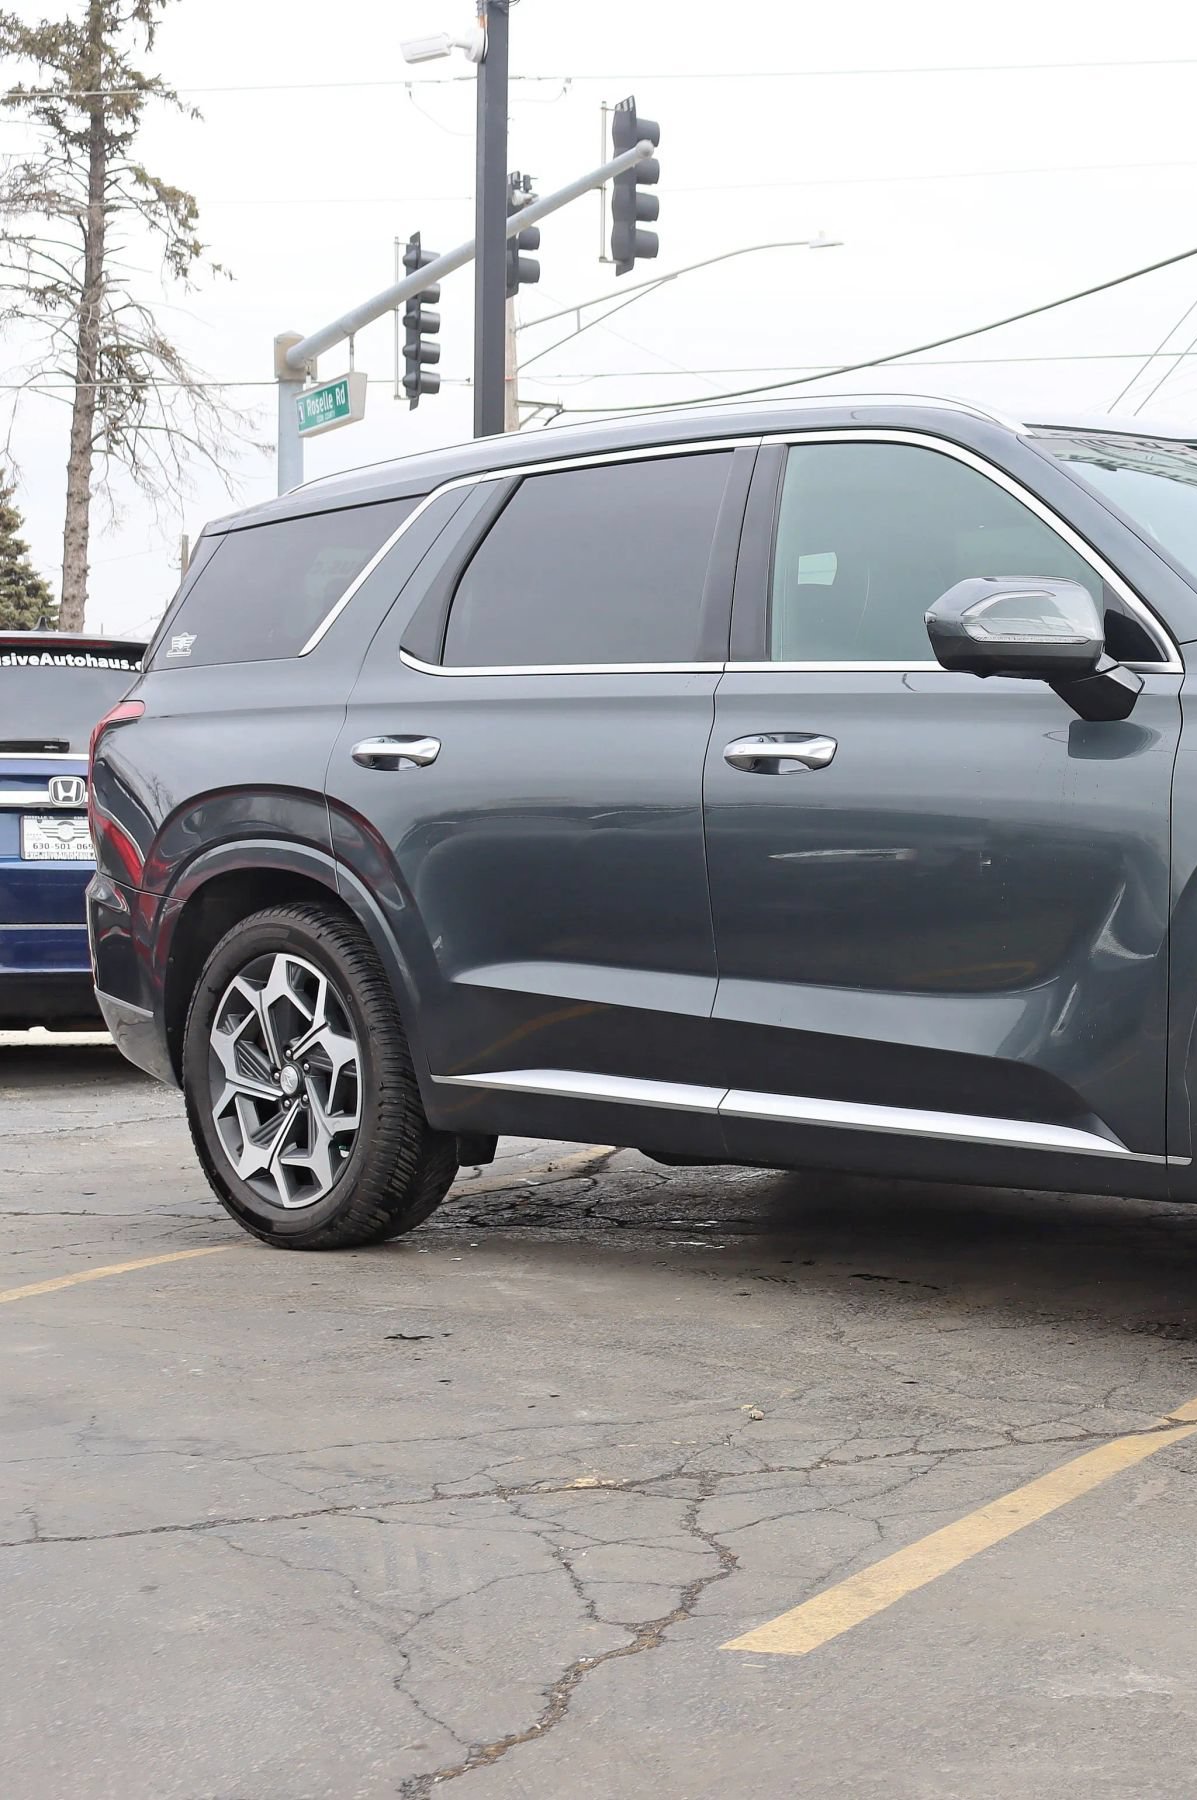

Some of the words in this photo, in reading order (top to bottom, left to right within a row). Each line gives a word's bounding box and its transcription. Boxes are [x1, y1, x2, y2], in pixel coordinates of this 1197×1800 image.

[306, 390, 334, 417] Roselle
[335, 383, 346, 407] Rd
[0, 652, 142, 671] siveAutohaus.c
